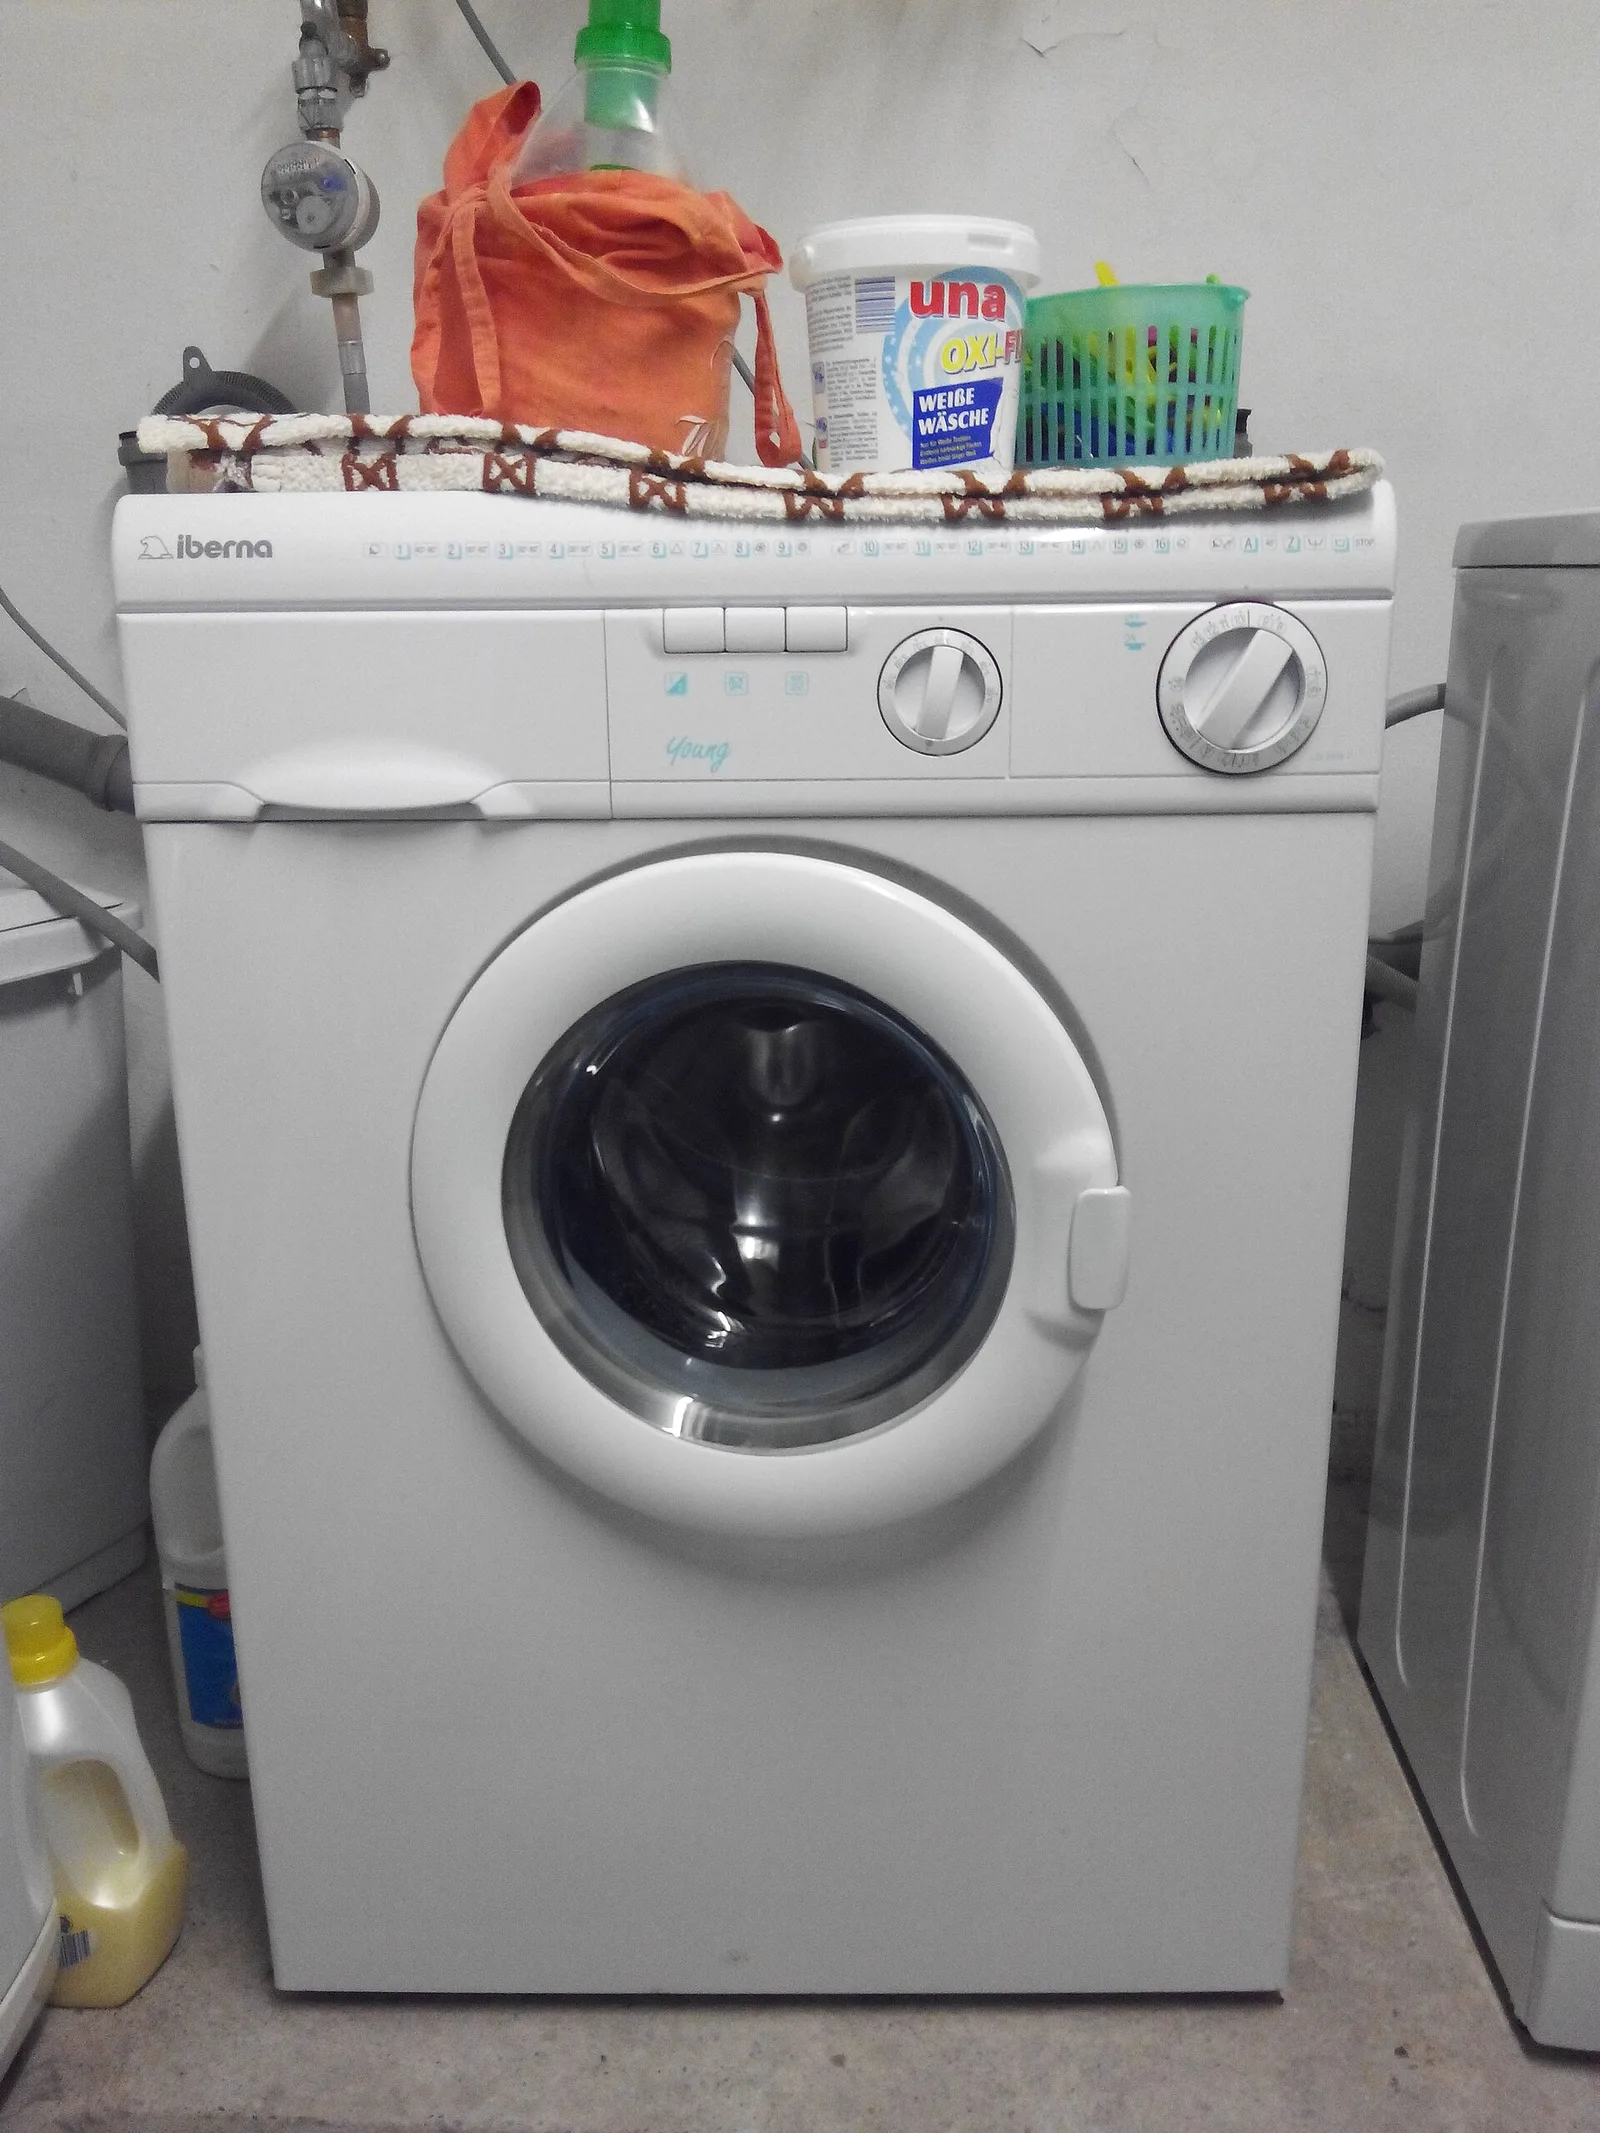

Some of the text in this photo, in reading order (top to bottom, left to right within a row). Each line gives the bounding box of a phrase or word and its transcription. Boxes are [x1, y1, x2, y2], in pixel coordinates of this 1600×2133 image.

[910, 281, 1006, 322] una
[918, 387, 975, 413] WEIßE
[918, 407, 990, 436] WÄSCHE
[176, 534, 273, 559] iberna
[666, 736, 731, 773] Young
